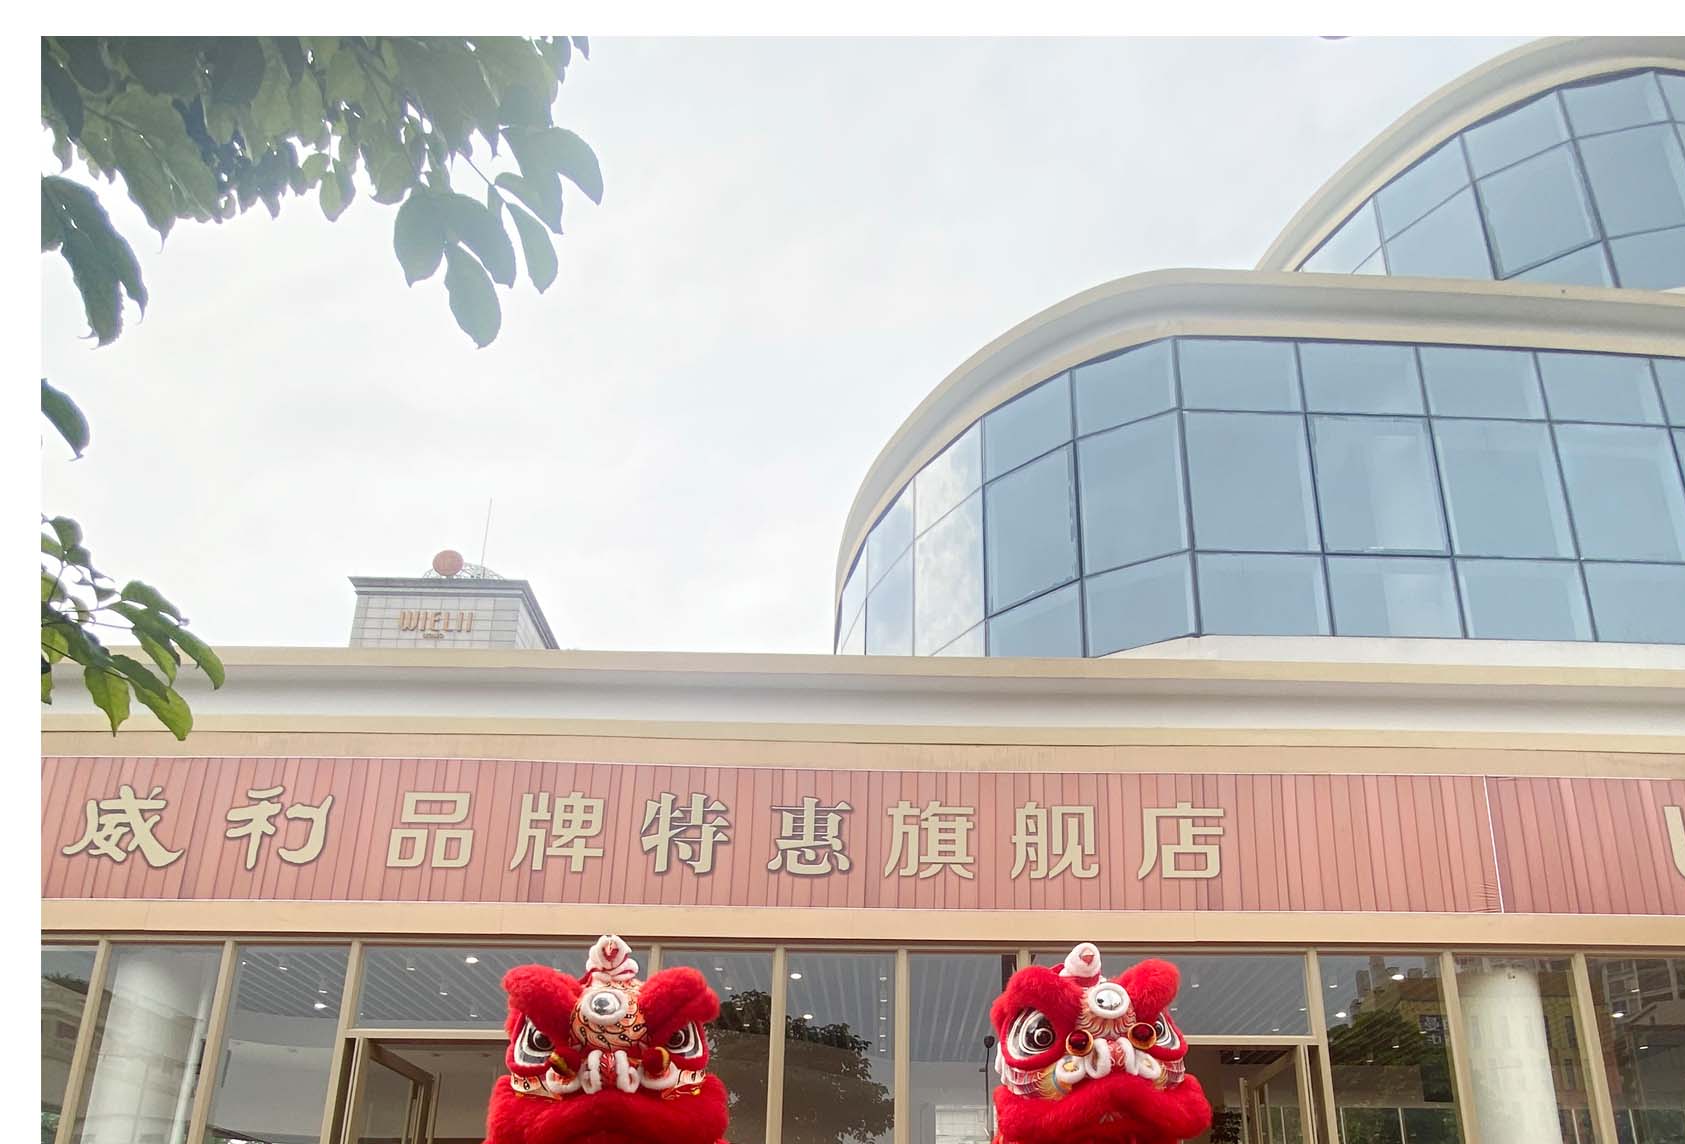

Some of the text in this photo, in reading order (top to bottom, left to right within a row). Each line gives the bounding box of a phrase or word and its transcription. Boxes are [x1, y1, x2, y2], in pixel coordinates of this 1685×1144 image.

[62, 785, 1225, 879] 威利品牌特惠旗舰店
